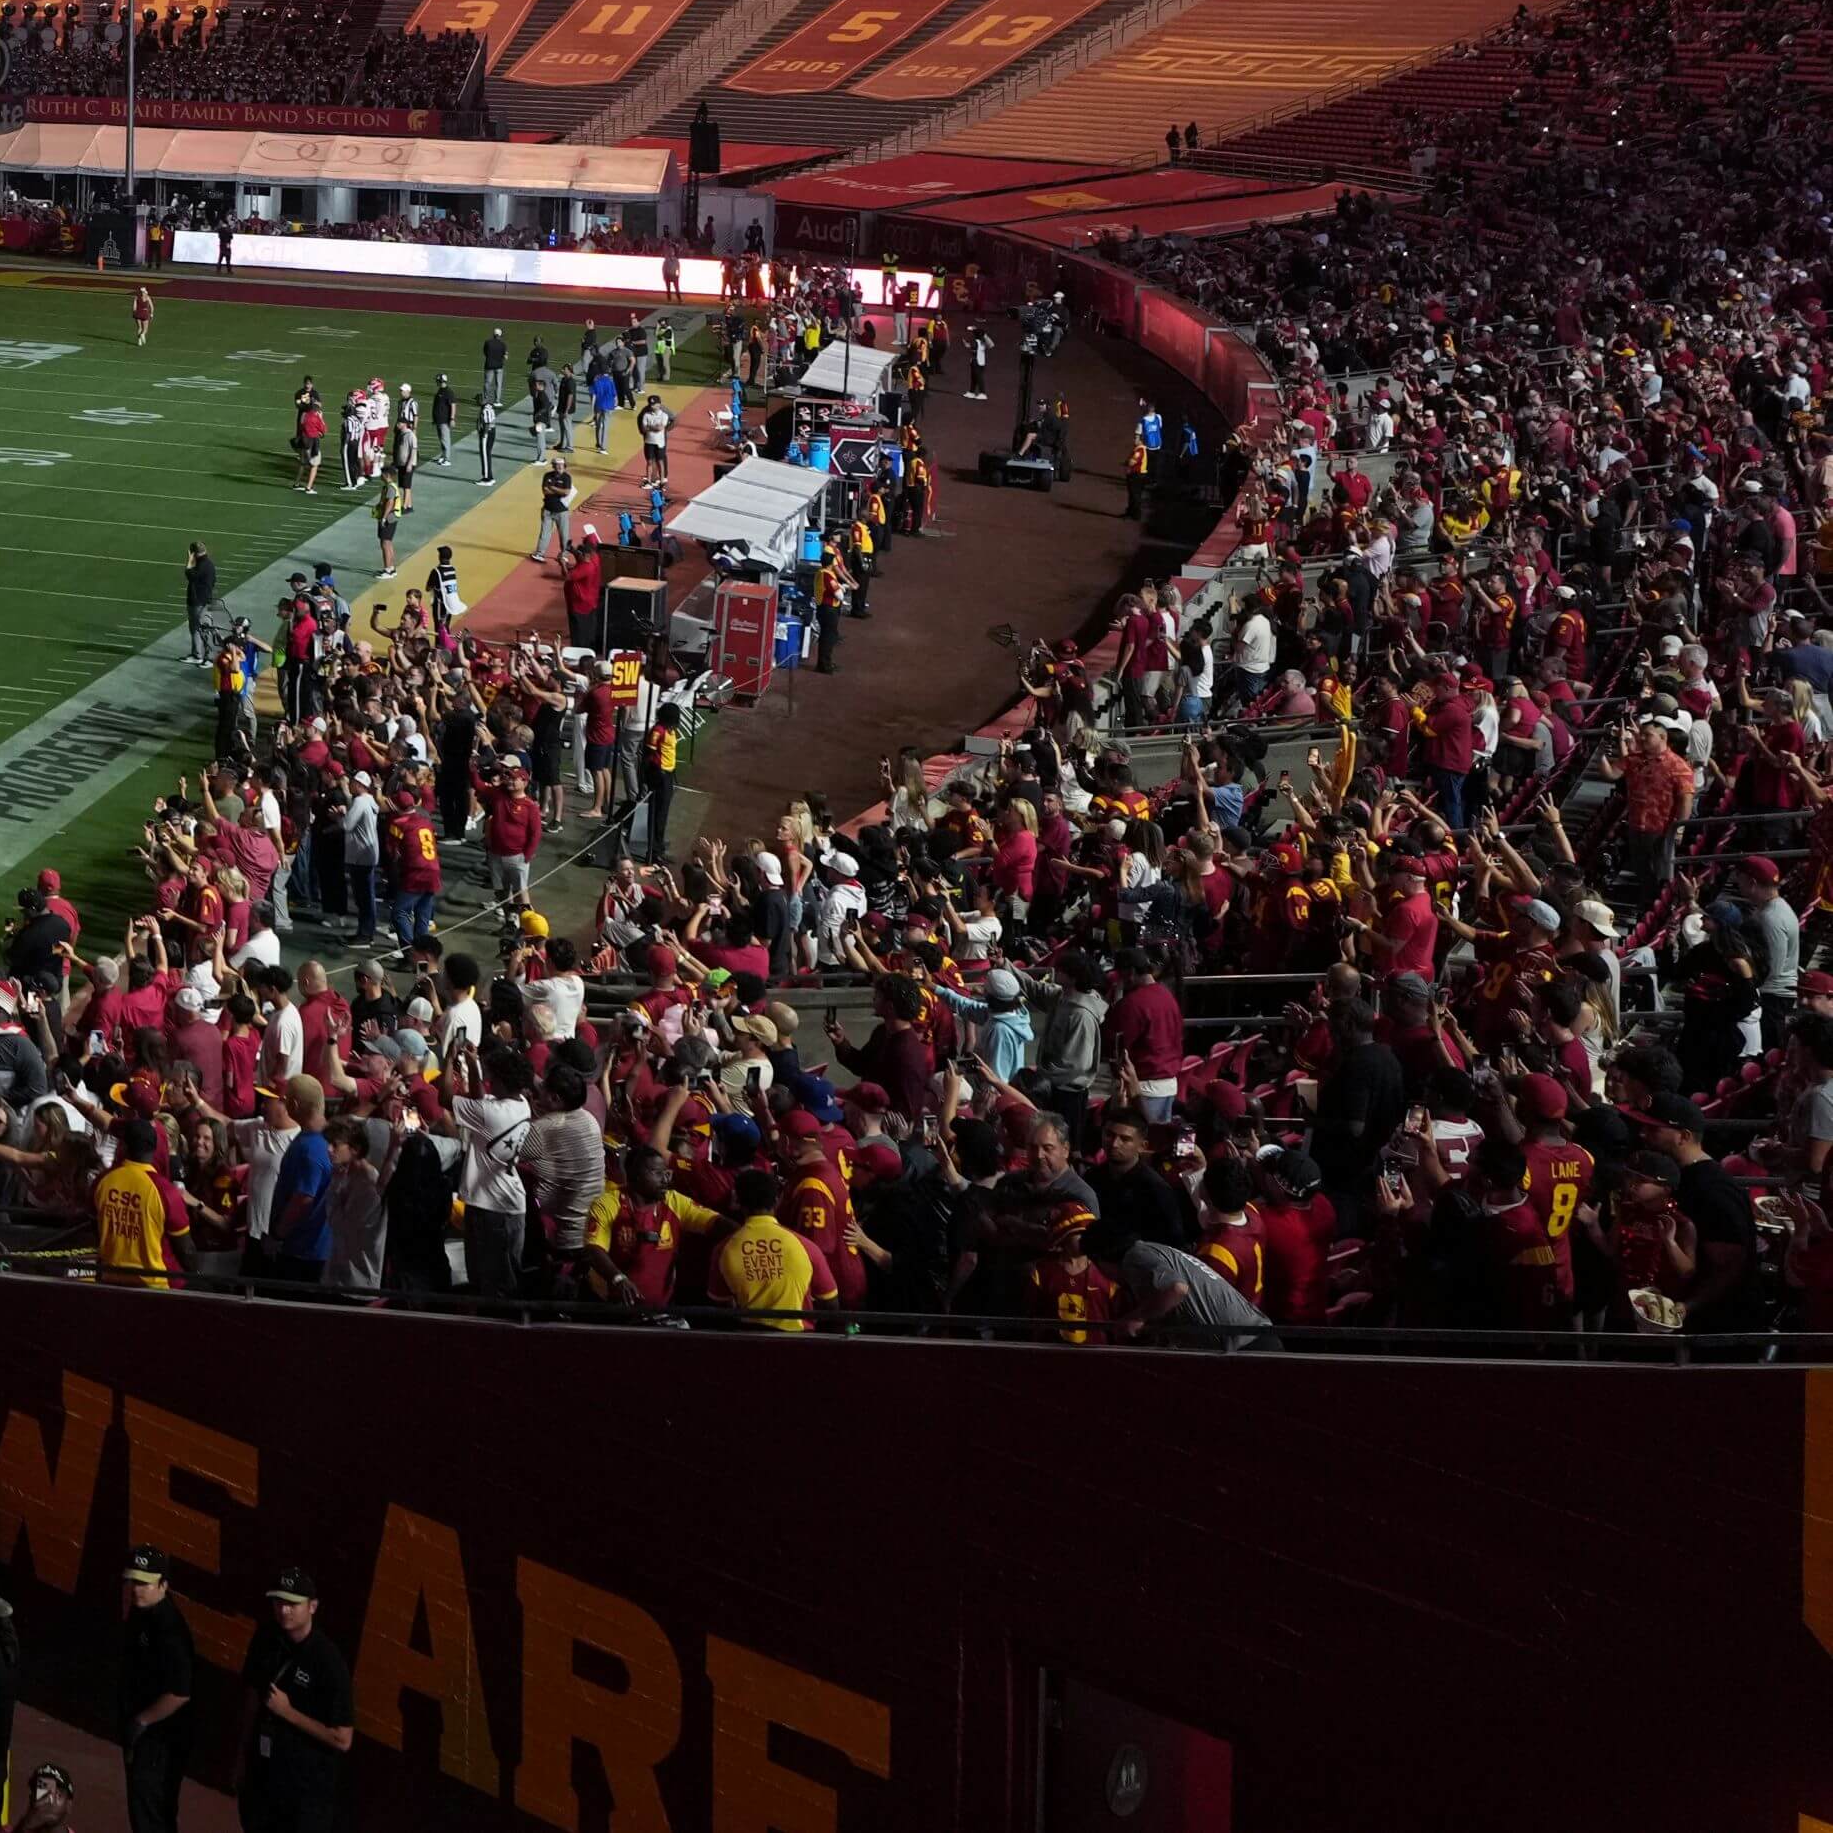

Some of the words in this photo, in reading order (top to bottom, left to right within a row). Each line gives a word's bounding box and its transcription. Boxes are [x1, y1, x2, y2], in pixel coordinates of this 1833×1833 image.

[445, 0, 500, 29] 3
[578, 4, 652, 35] 11
[827, 11, 901, 42] 5
[947, 14, 1054, 46] 13
[539, 52, 621, 65] 2004
[762, 60, 846, 74] 2005
[895, 64, 980, 78] 2022
[26, 98, 77, 117] RUTH
[84, 100, 102, 117] C.
[171, 103, 235, 122] FAMILY
[244, 107, 298, 125] BAND
[306, 109, 391, 127] SECTION
[612, 660, 640, 686] SW
[418, 828, 436, 860] 8
[1551, 1160, 1582, 1179] LANE
[108, 1189, 142, 1207] CSC
[221, 1191, 232, 1208] 4
[1547, 1182, 1579, 1237] 8
[804, 1205, 826, 1228] 33
[741, 1238, 782, 1256] CSC
[742, 1254, 784, 1269] EVENT
[744, 1267, 784, 1282] STAFF
[354, 1503, 891, 1833] ARE
